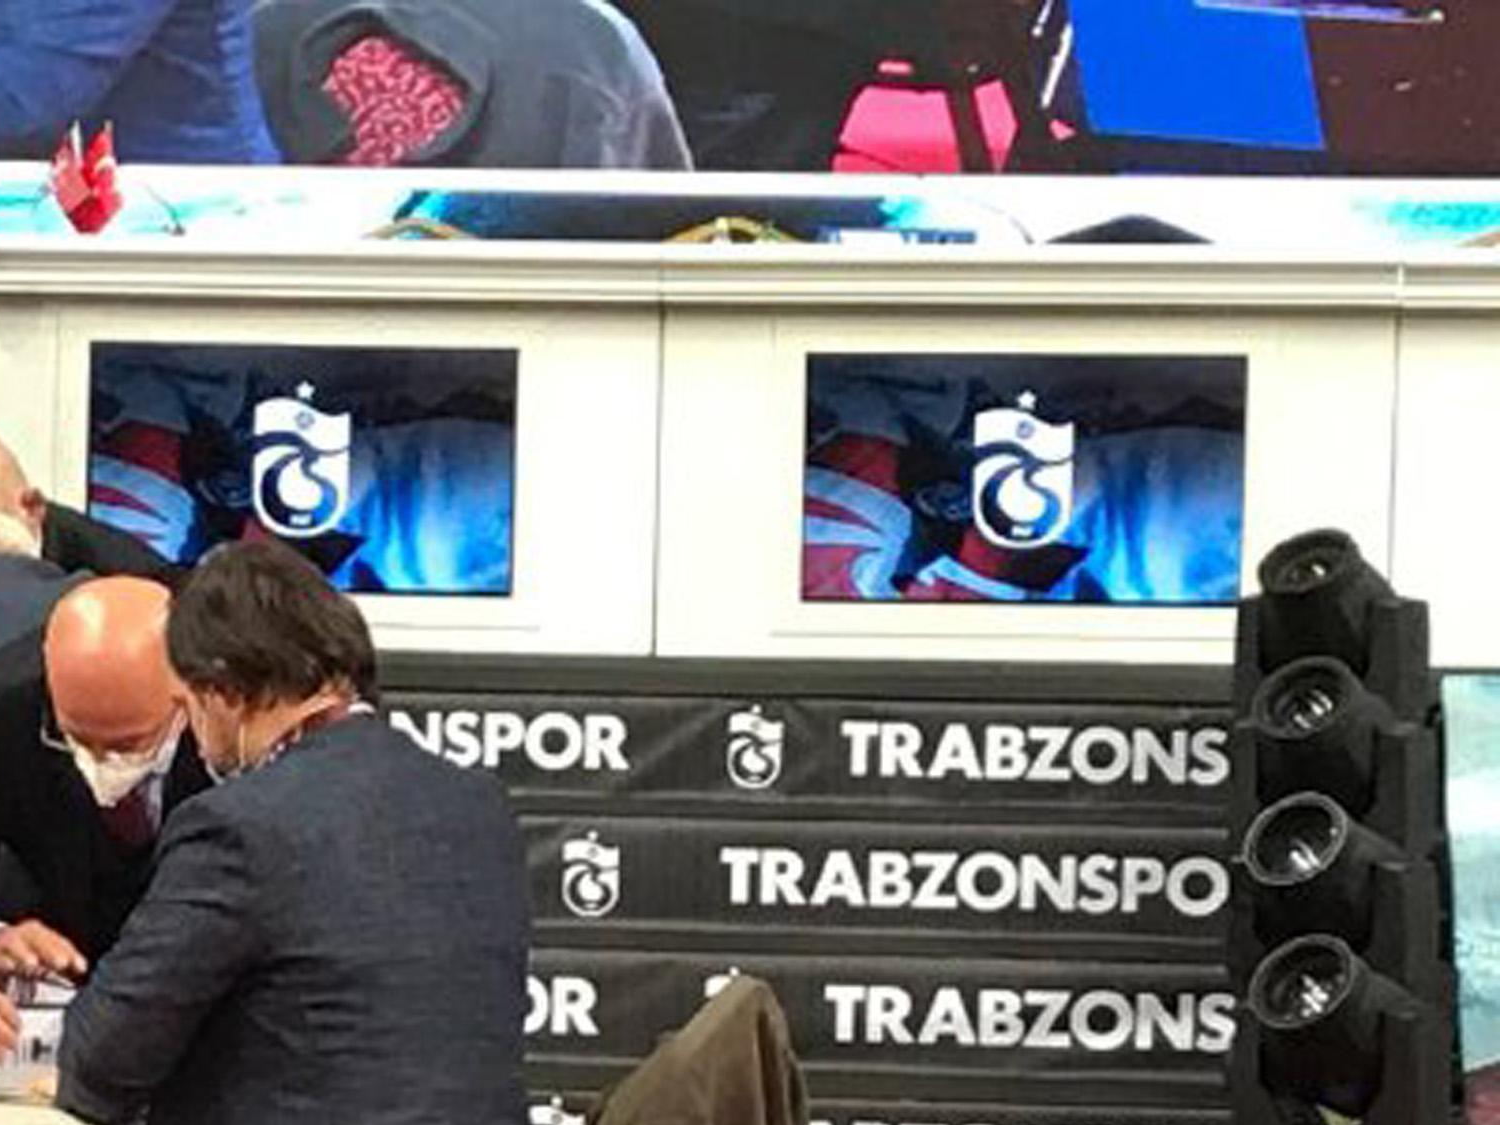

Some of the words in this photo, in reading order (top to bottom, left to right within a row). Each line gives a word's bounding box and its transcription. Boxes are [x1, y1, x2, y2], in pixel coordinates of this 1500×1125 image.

[389, 710, 630, 770] NSPOR
[841, 719, 1231, 785] TRABZONS
[720, 846, 1231, 917] TRABZONSPO
[824, 984, 1238, 1053] TRABZONS
